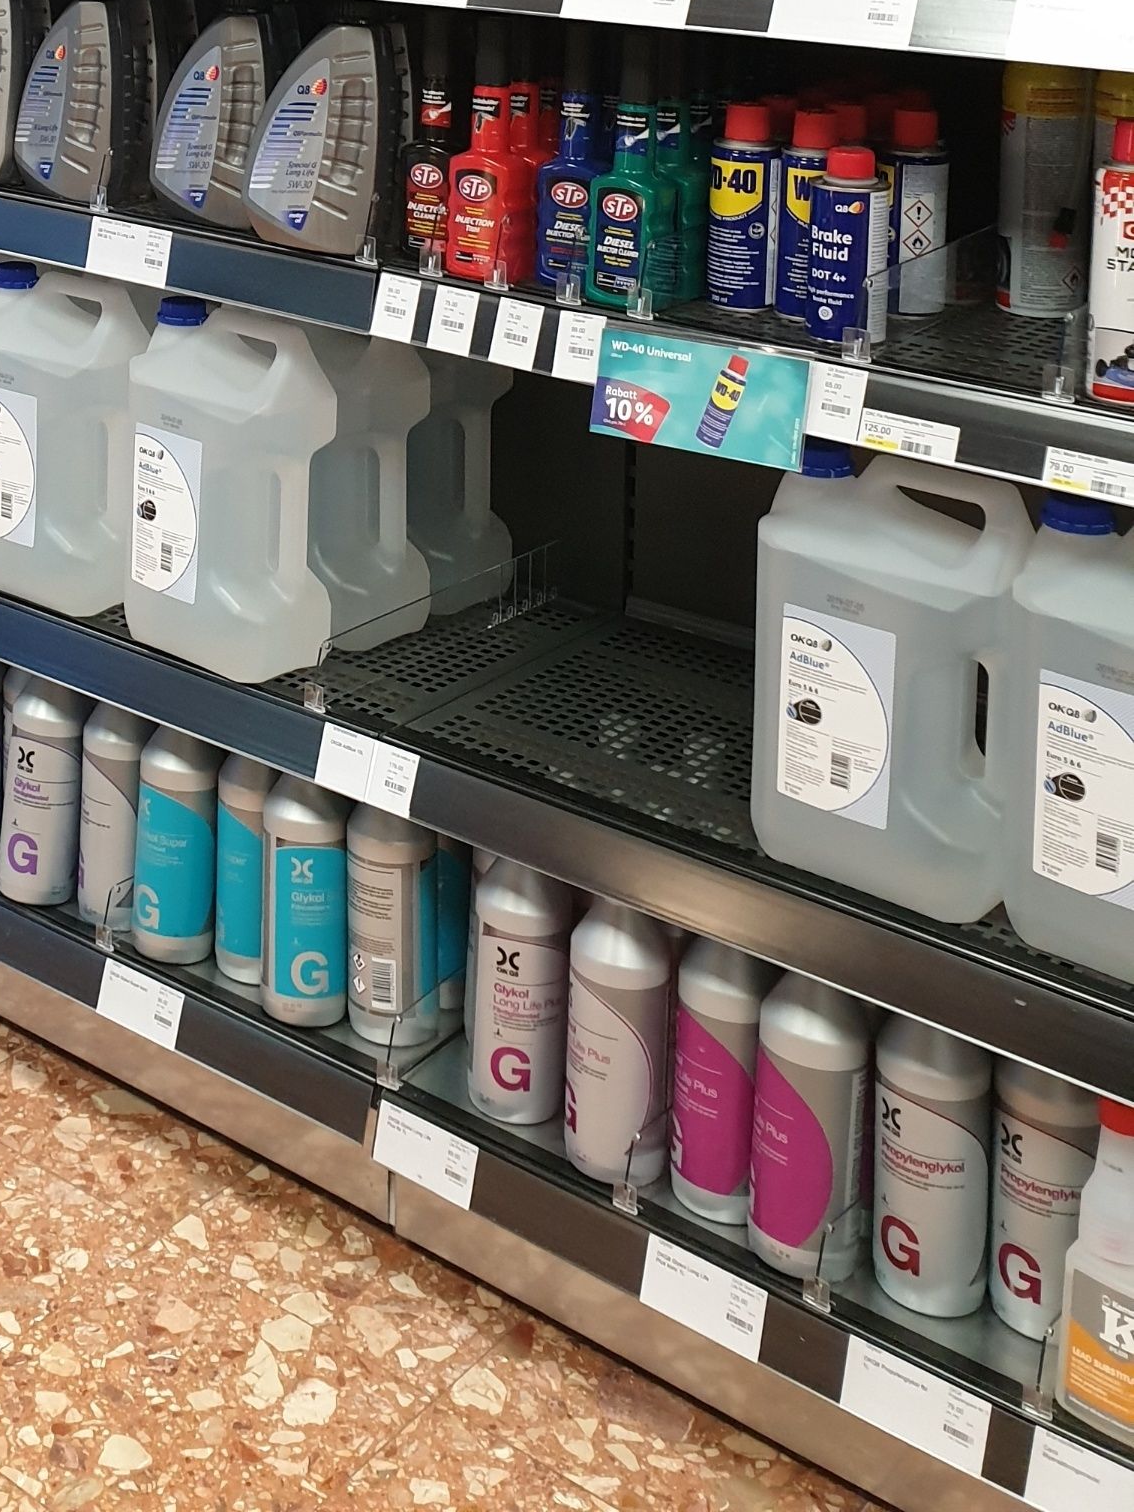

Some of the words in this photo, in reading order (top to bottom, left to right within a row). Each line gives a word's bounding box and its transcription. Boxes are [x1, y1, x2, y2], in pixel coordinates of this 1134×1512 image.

[297, 84, 311, 96] Q8
[413, 166, 440, 186] STP
[461, 177, 489, 199] STP
[553, 184, 586, 208] STP
[605, 195, 636, 220] STP
[454, 214, 495, 229] INJECTION
[603, 236, 635, 250] DIESEL
[811, 224, 853, 247] Brake
[811, 242, 849, 263] Fluid
[812, 268, 831, 281] DOT
[833, 271, 847, 284] 4+
[611, 339, 645, 355] WD-40
[646, 345, 693, 363] Universal
[605, 385, 638, 400] Rabatt
[715, 380, 742, 403] WD-40
[605, 397, 654, 426] 10%
[864, 422, 892, 436] 125.00
[1049, 461, 1075, 475] 79.00
[788, 678, 802, 689] Euro
[1046, 749, 1063, 762] Euro
[13, 777, 42, 793] Glykol
[7, 832, 40, 877] G
[136, 883, 160, 930] G
[290, 890, 326, 904] Glykol
[289, 950, 330, 996] G
[493, 982, 530, 1001] Glykol
[493, 994, 521, 1012] Long
[522, 998, 543, 1012] Life
[585, 1046, 611, 1065] Plus
[489, 1045, 531, 1093] G
[693, 1078, 718, 1099] Plus
[764, 1122, 788, 1145] Plus
[880, 1136, 965, 1174] Propylenglykol
[880, 1214, 921, 1278] G
[997, 1241, 1043, 1306] G
[1071, 1345, 1093, 1365] LEAD
